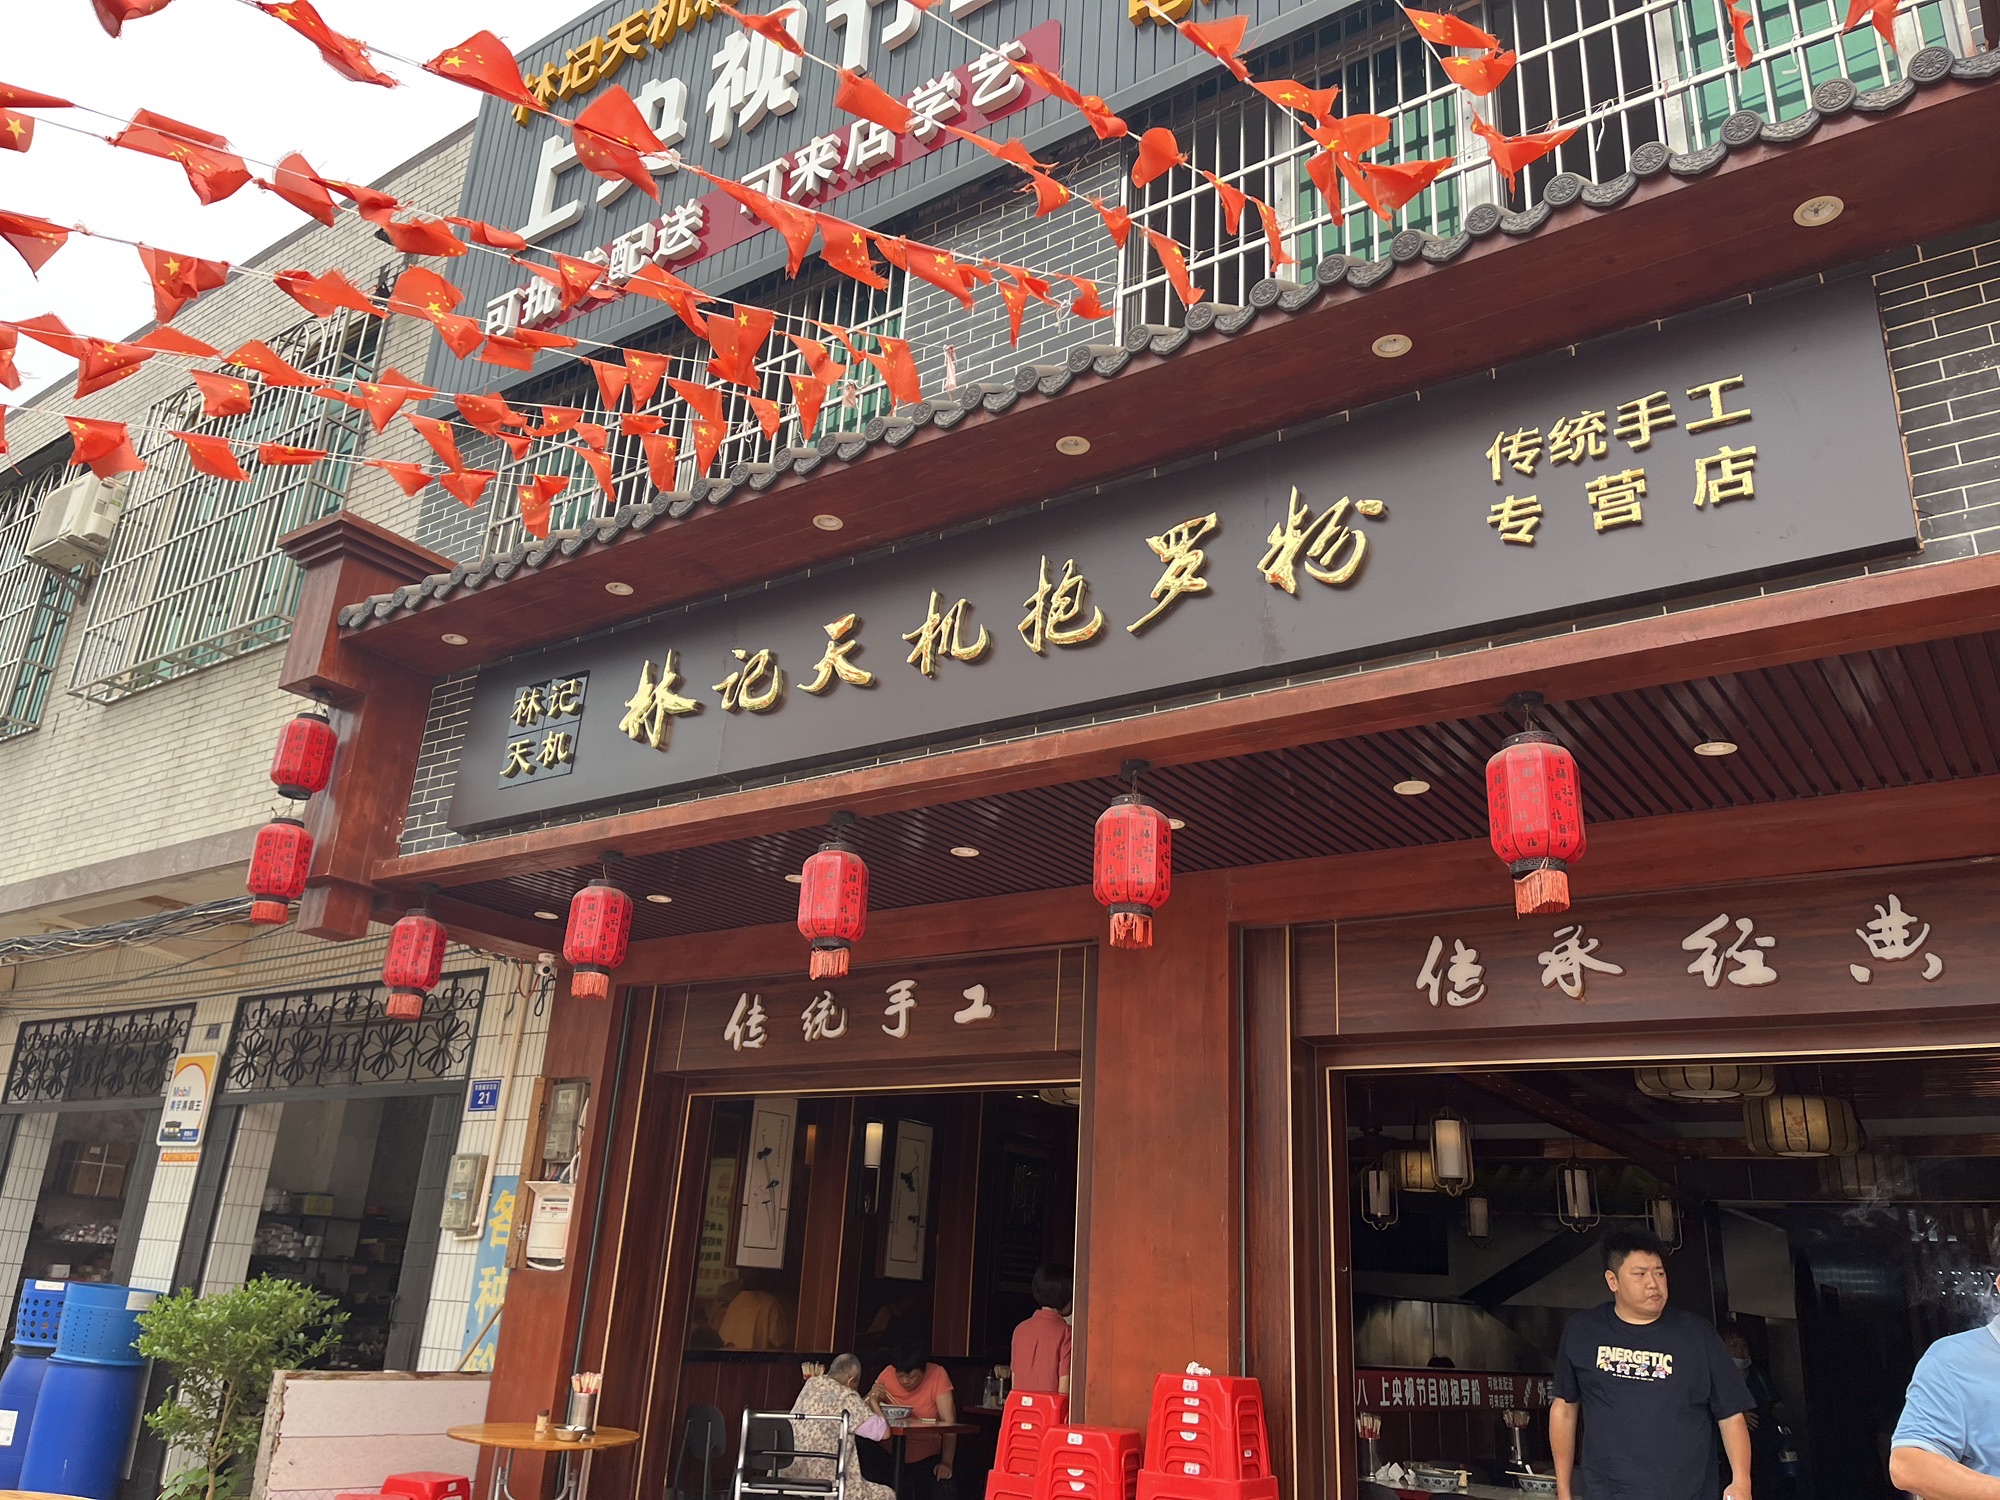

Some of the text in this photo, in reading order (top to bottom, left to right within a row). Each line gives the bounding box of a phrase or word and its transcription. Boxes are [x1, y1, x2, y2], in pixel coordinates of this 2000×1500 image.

[511, 0, 740, 128] 林记天机
[1485, 373, 1754, 484] 传统手工
[1486, 444, 1758, 546] 专营店
[618, 484, 1390, 751] 林记天机抱罗粉
[510, 678, 583, 728] 林记
[499, 730, 574, 779] 天机
[1416, 893, 1943, 1007] 传承经典
[723, 979, 996, 1052] 传统手工
[172, 1086, 192, 1098] Mobil
[477, 1091, 491, 1105] 21
[1596, 1345, 1673, 1375] ENERGETIC
